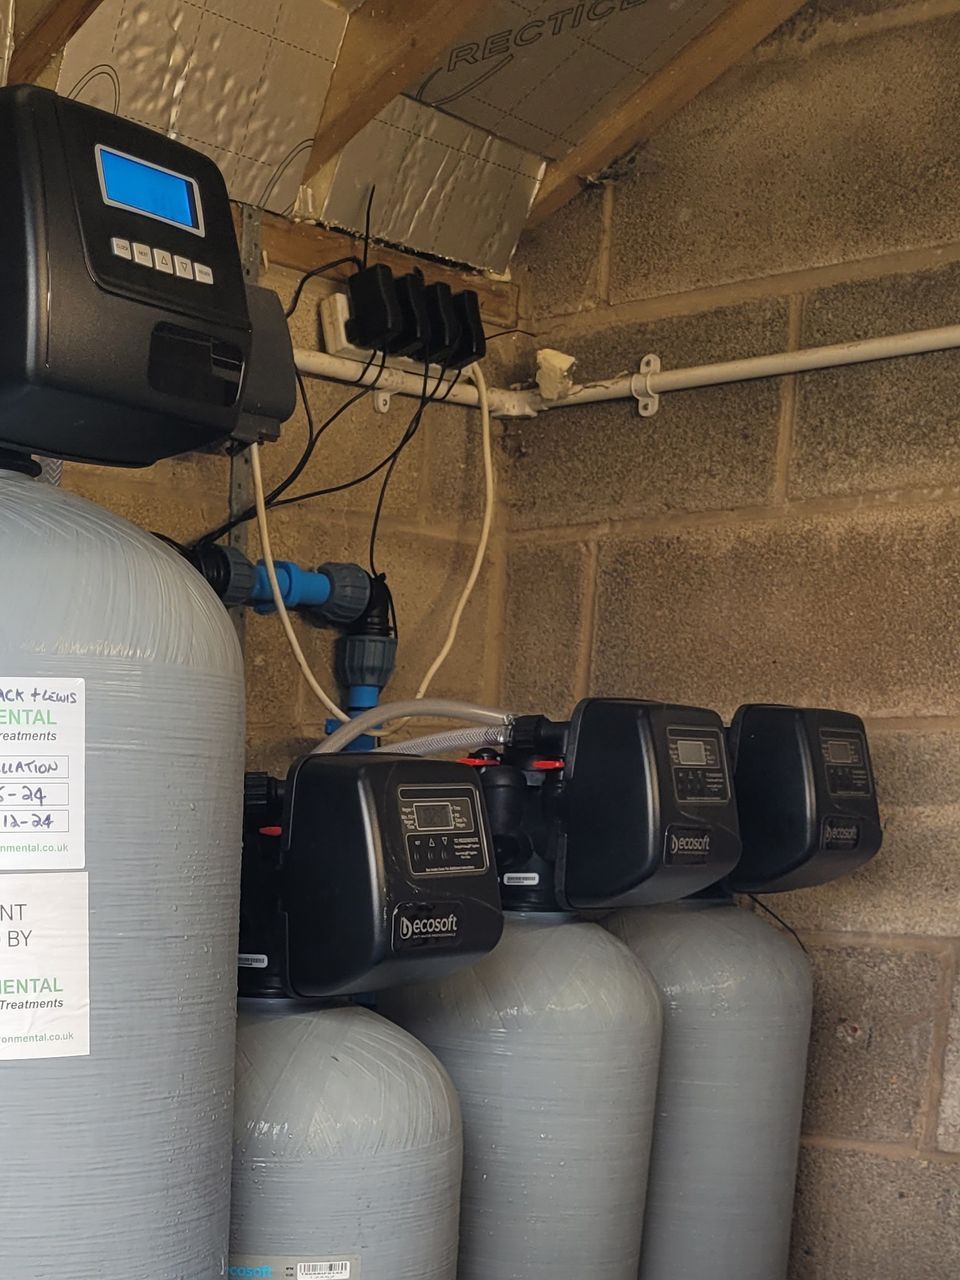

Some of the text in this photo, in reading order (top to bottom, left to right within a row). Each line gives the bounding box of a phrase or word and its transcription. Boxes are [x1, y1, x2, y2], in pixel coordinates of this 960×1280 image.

[678, 835, 710, 850] ecosoft
[413, 914, 457, 933] ecosoft
[8, 930, 32, 948] BY
[0, 998, 64, 1010] Treatments
